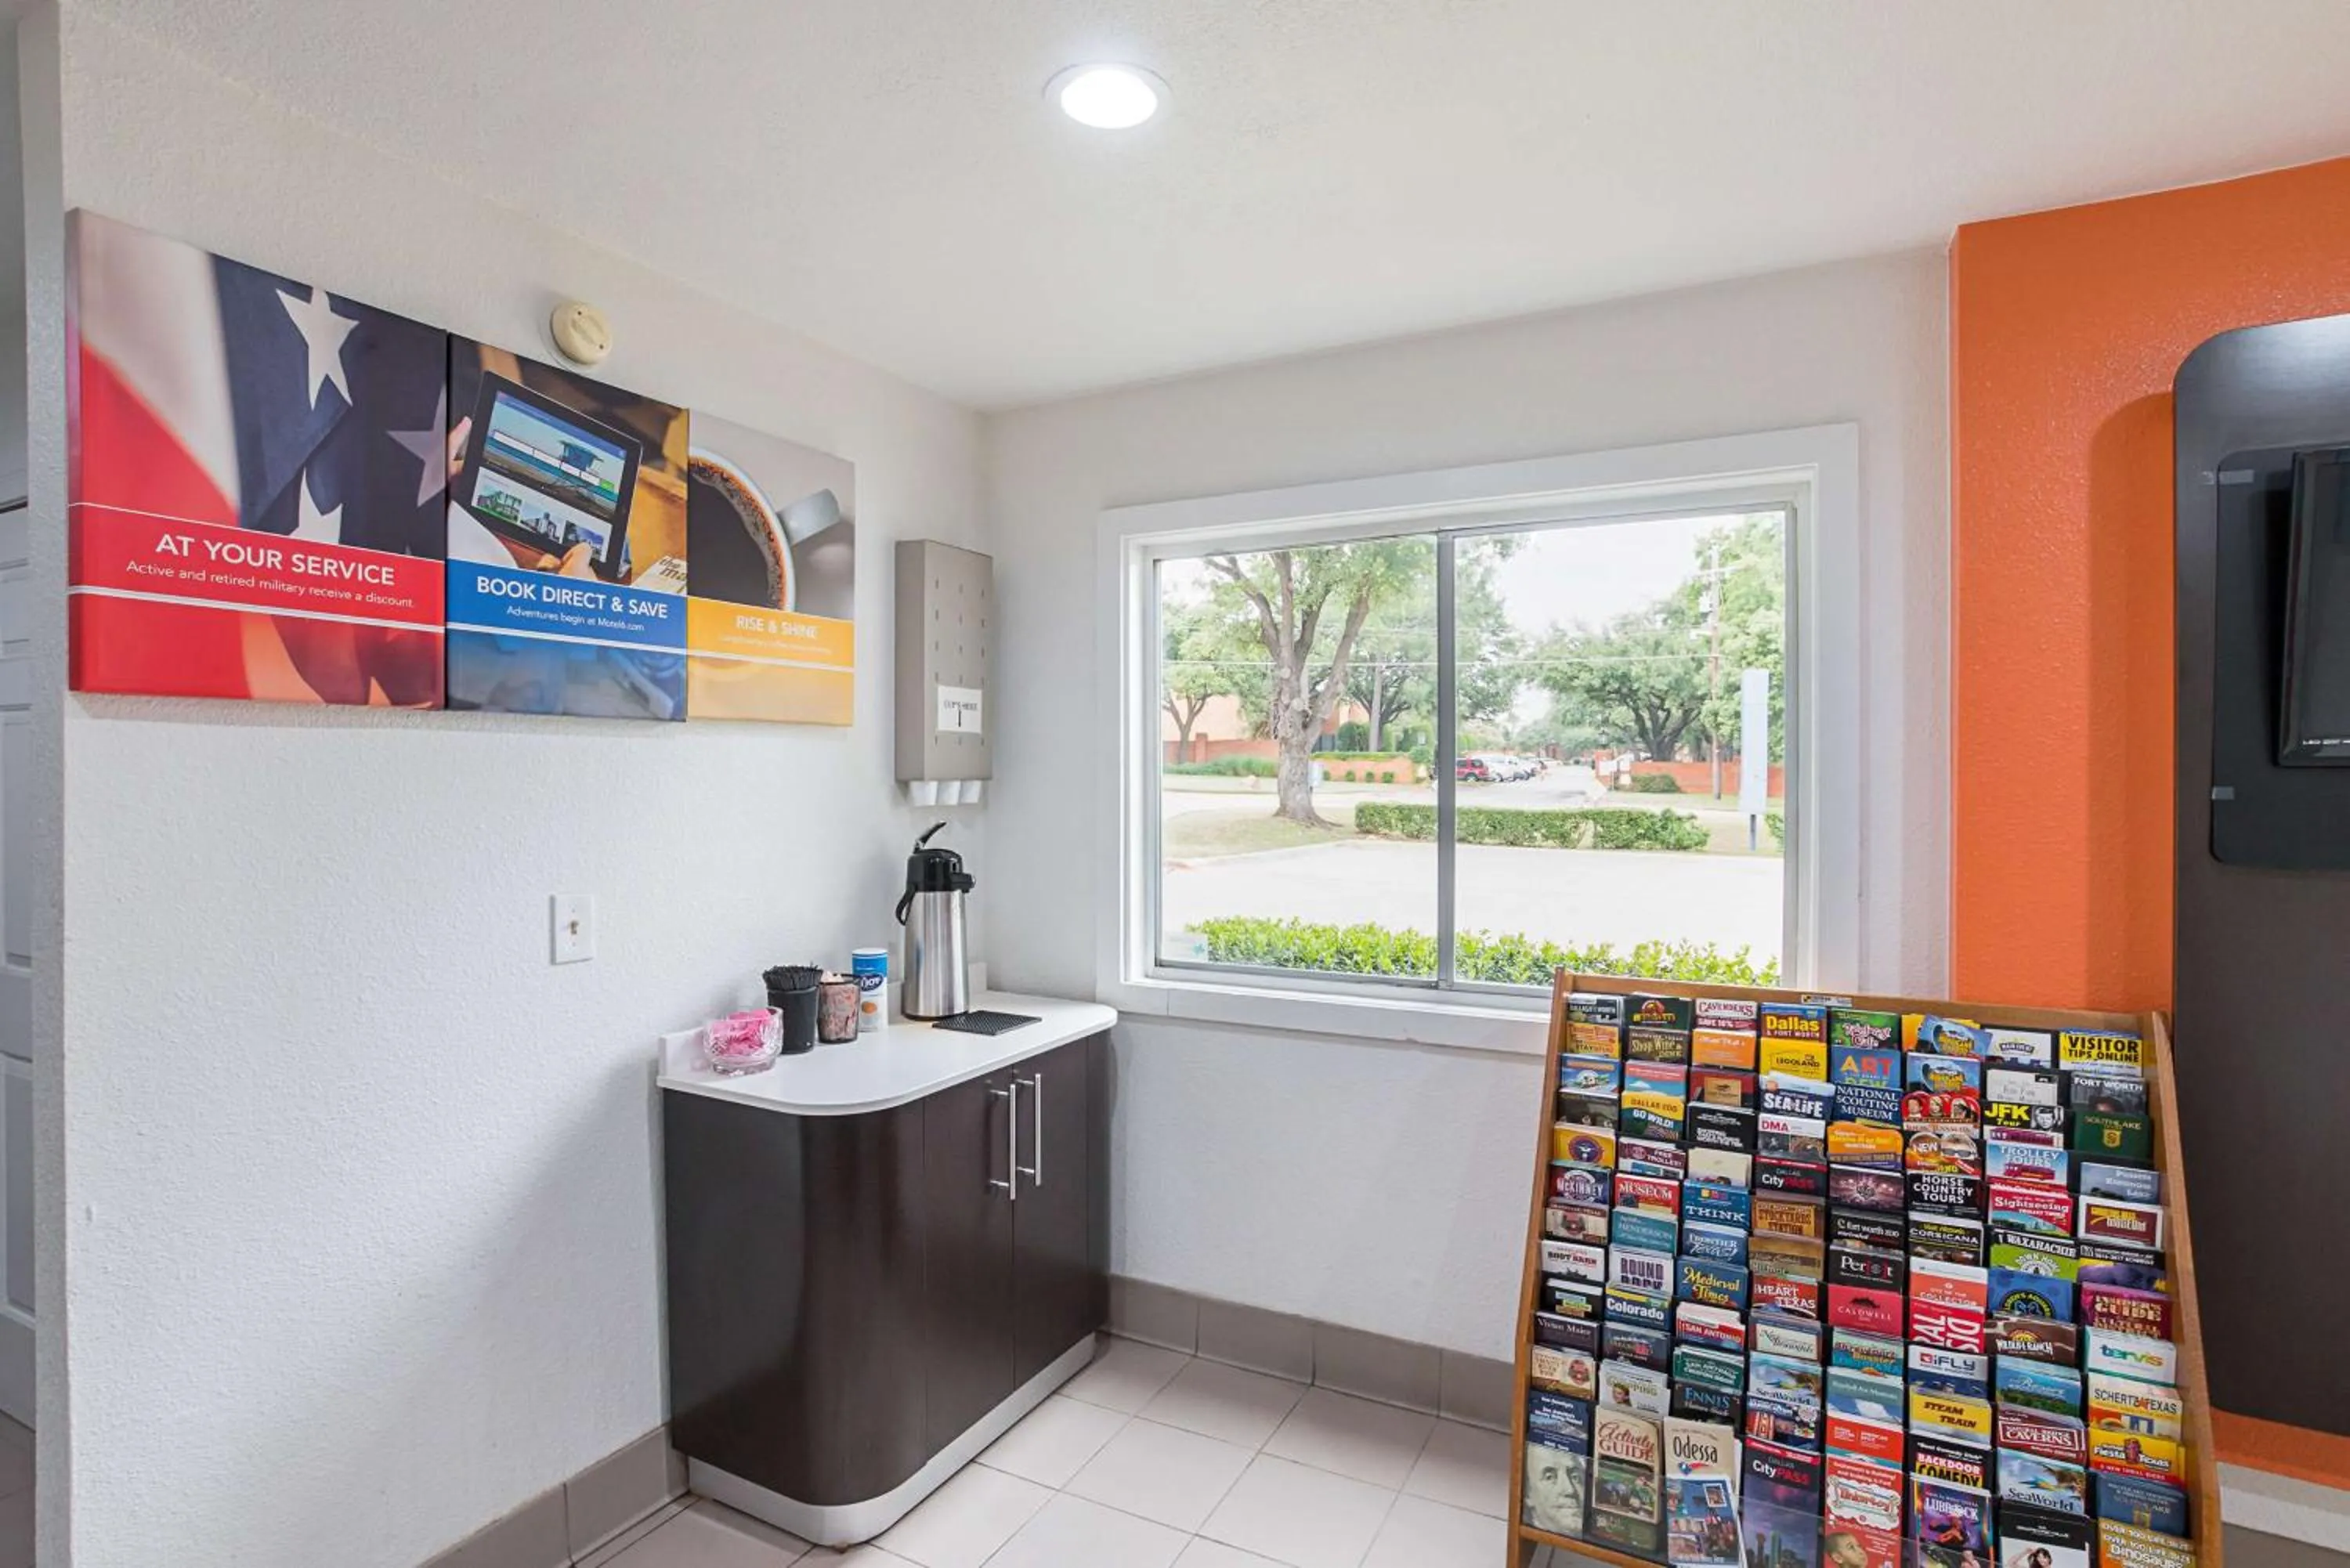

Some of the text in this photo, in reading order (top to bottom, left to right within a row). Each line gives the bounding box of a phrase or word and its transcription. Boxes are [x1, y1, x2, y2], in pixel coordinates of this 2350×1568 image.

[155, 533, 395, 586] AT YOUR SERVICE
[126, 560, 175, 577] Active
[179, 569, 206, 582] and
[210, 573, 255, 587] retired
[259, 579, 306, 597] military
[309, 586, 352, 600] receive
[355, 593, 363, 602] a
[476, 576, 668, 618] BOOK DIRECT & SAVE
[507, 605, 559, 622] Adventures
[560, 611, 586, 627] begin
[588, 616, 597, 626] at
[736, 615, 765, 632] RISE
[781, 621, 818, 639] SHINE
[1766, 1015, 1820, 1031] Dallas
[2067, 1035, 2139, 1053] VISITOR
[2068, 1049, 2139, 1063] TIPS ONLINE
[1841, 1054, 1893, 1077] ART
[2074, 1076, 2143, 1092] FORT WORTH
[1763, 1092, 1791, 1111] SEA
[1837, 1085, 1900, 1102] NATIONAL
[1836, 1094, 1899, 1112] SCOUTING
[1984, 1103, 2031, 1121] JFK
[1842, 1105, 1893, 1121] MUSEUM
[1997, 1118, 2021, 1126] Tour
[1761, 1120, 1790, 1133] DMA
[2084, 1115, 2142, 1130] SOUTHLAKE
[1914, 1140, 1938, 1152] NEW
[2000, 1145, 2060, 1161] TROLLEY
[1913, 1183, 1974, 1197] COUNTRY
[1922, 1175, 1964, 1187] HORSE
[1618, 1183, 1673, 1200] MUSEUM
[1922, 1191, 1965, 1204] TOURS
[1994, 1195, 2070, 1214] Sightseeing
[1685, 1205, 1745, 1223] THINK
[1910, 1227, 1979, 1245] CORSICANA
[1620, 1257, 1665, 1281] ROUND
[1683, 1265, 1741, 1292] Medieval
[1692, 1284, 1730, 1302] Times
[1758, 1284, 1799, 1298] HEART
[1607, 1297, 1665, 1321] Colorado
[1774, 1295, 1817, 1310] TEXAS
[1837, 1305, 1893, 1321] CALDWELL
[1933, 1353, 1976, 1371] iFLY
[2099, 1343, 2165, 1367] tervis
[1685, 1386, 1731, 1410] ENNIS
[1923, 1401, 1965, 1415] STEAM
[1939, 1414, 1977, 1429] TRAIN
[2005, 1429, 2073, 1447] CAVERNS
[1599, 1440, 1654, 1462] GUIDE
[1673, 1434, 1719, 1464] Odessa
[1917, 1452, 1982, 1476] BACKDOOR
[1916, 1463, 1981, 1487] COMEDY
[2008, 1487, 2074, 1512] SeaWorld
